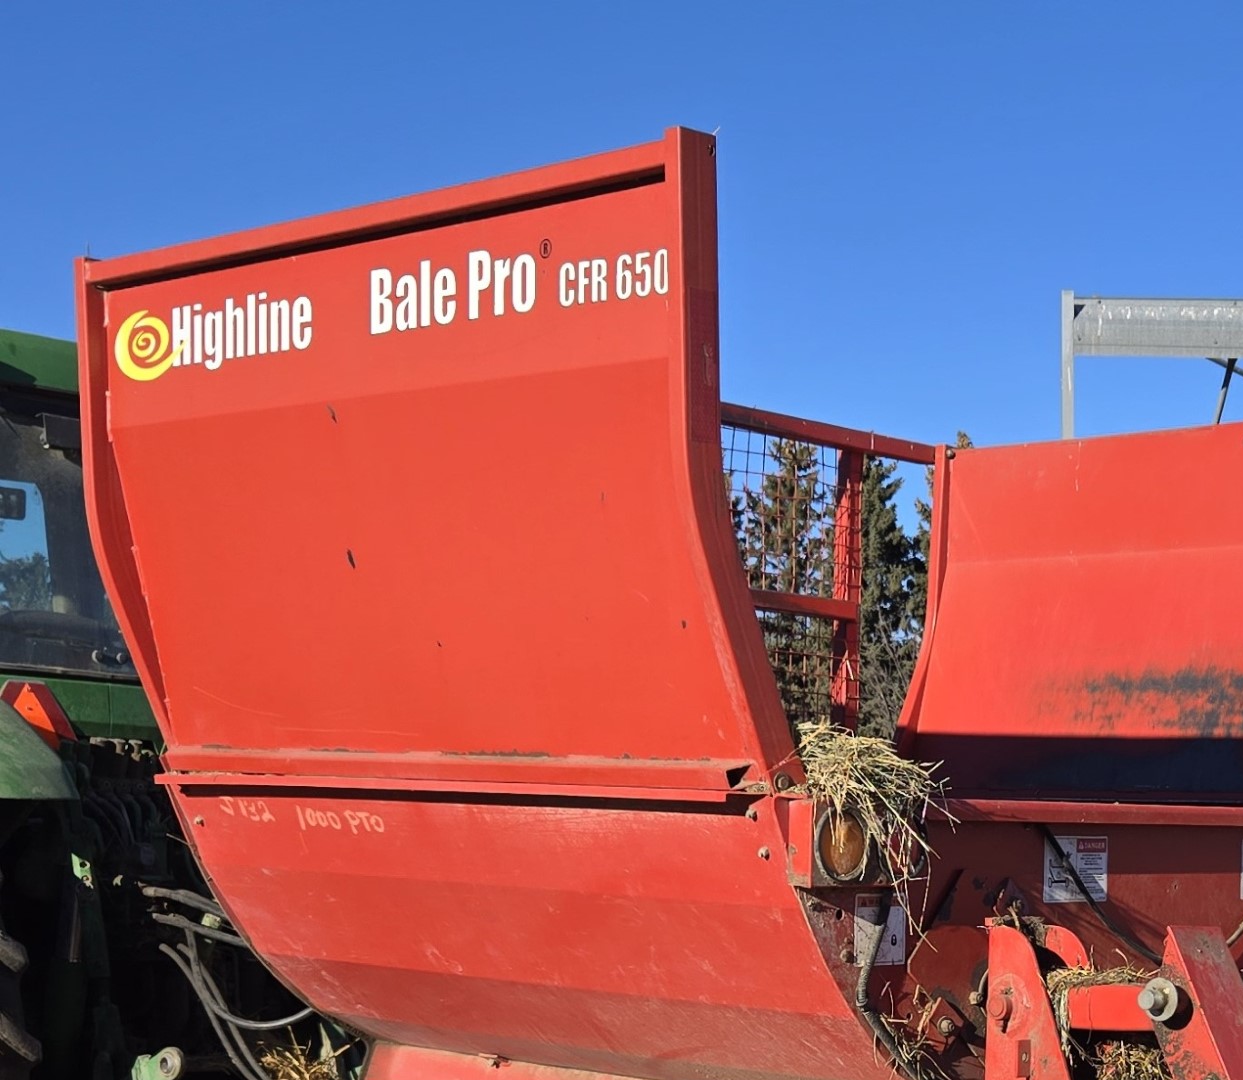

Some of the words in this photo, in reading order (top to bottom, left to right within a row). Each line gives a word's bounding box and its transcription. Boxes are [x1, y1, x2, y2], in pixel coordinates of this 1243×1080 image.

[370, 260, 457, 335] Bale
[559, 258, 608, 307] CFR
[615, 248, 669, 300] 650
[172, 292, 312, 370] Highline
[295, 804, 342, 831] 1000
[343, 809, 385, 835] PTO
